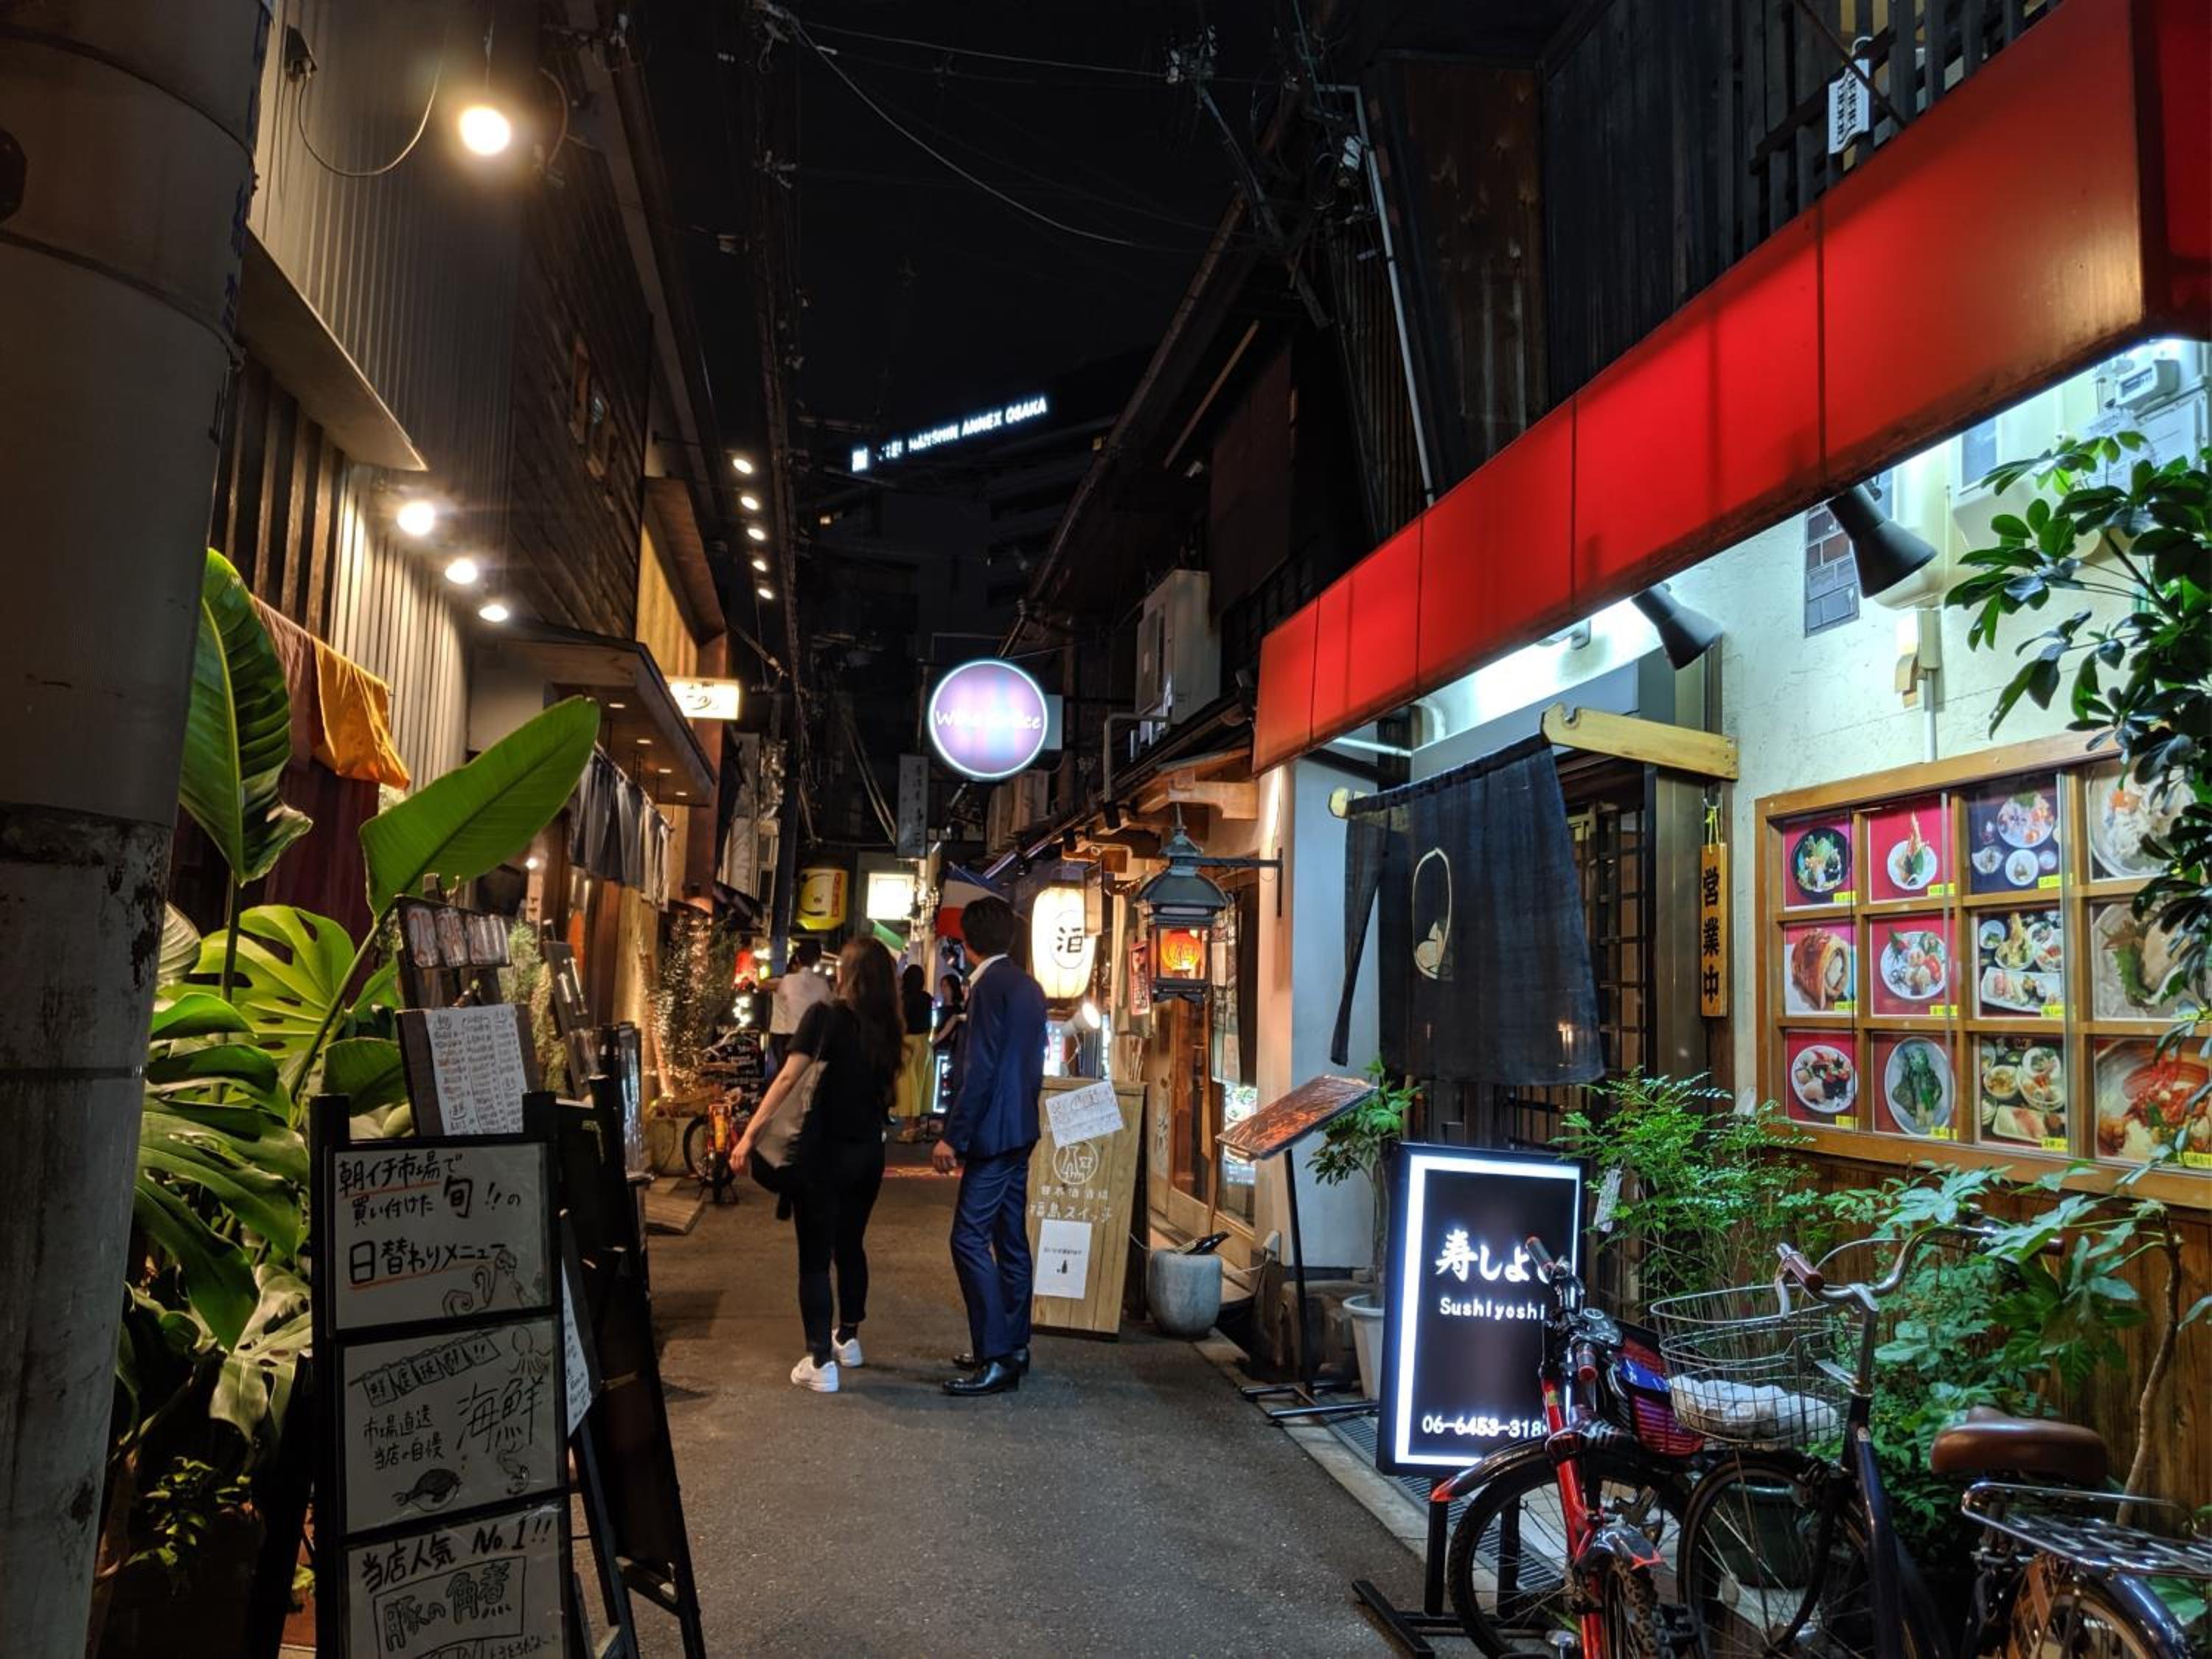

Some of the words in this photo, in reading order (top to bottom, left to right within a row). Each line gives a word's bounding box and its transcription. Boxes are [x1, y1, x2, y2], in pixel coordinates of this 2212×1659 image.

[961, 410, 1002, 437] ANNEX
[1005, 397, 1047, 424] OSAKA
[1057, 925, 1083, 954] 泊
[1703, 866, 1720, 1004] 営業中
[338, 1150, 464, 1194] 朝イチ市場で
[349, 1237, 507, 1286] 日替わりメニュー
[1439, 1297, 1545, 1321] Sushiyoshi
[364, 1403, 435, 1448] 市場直送
[456, 1374, 544, 1454] 海鮮
[362, 1534, 456, 1593] 当店人気
